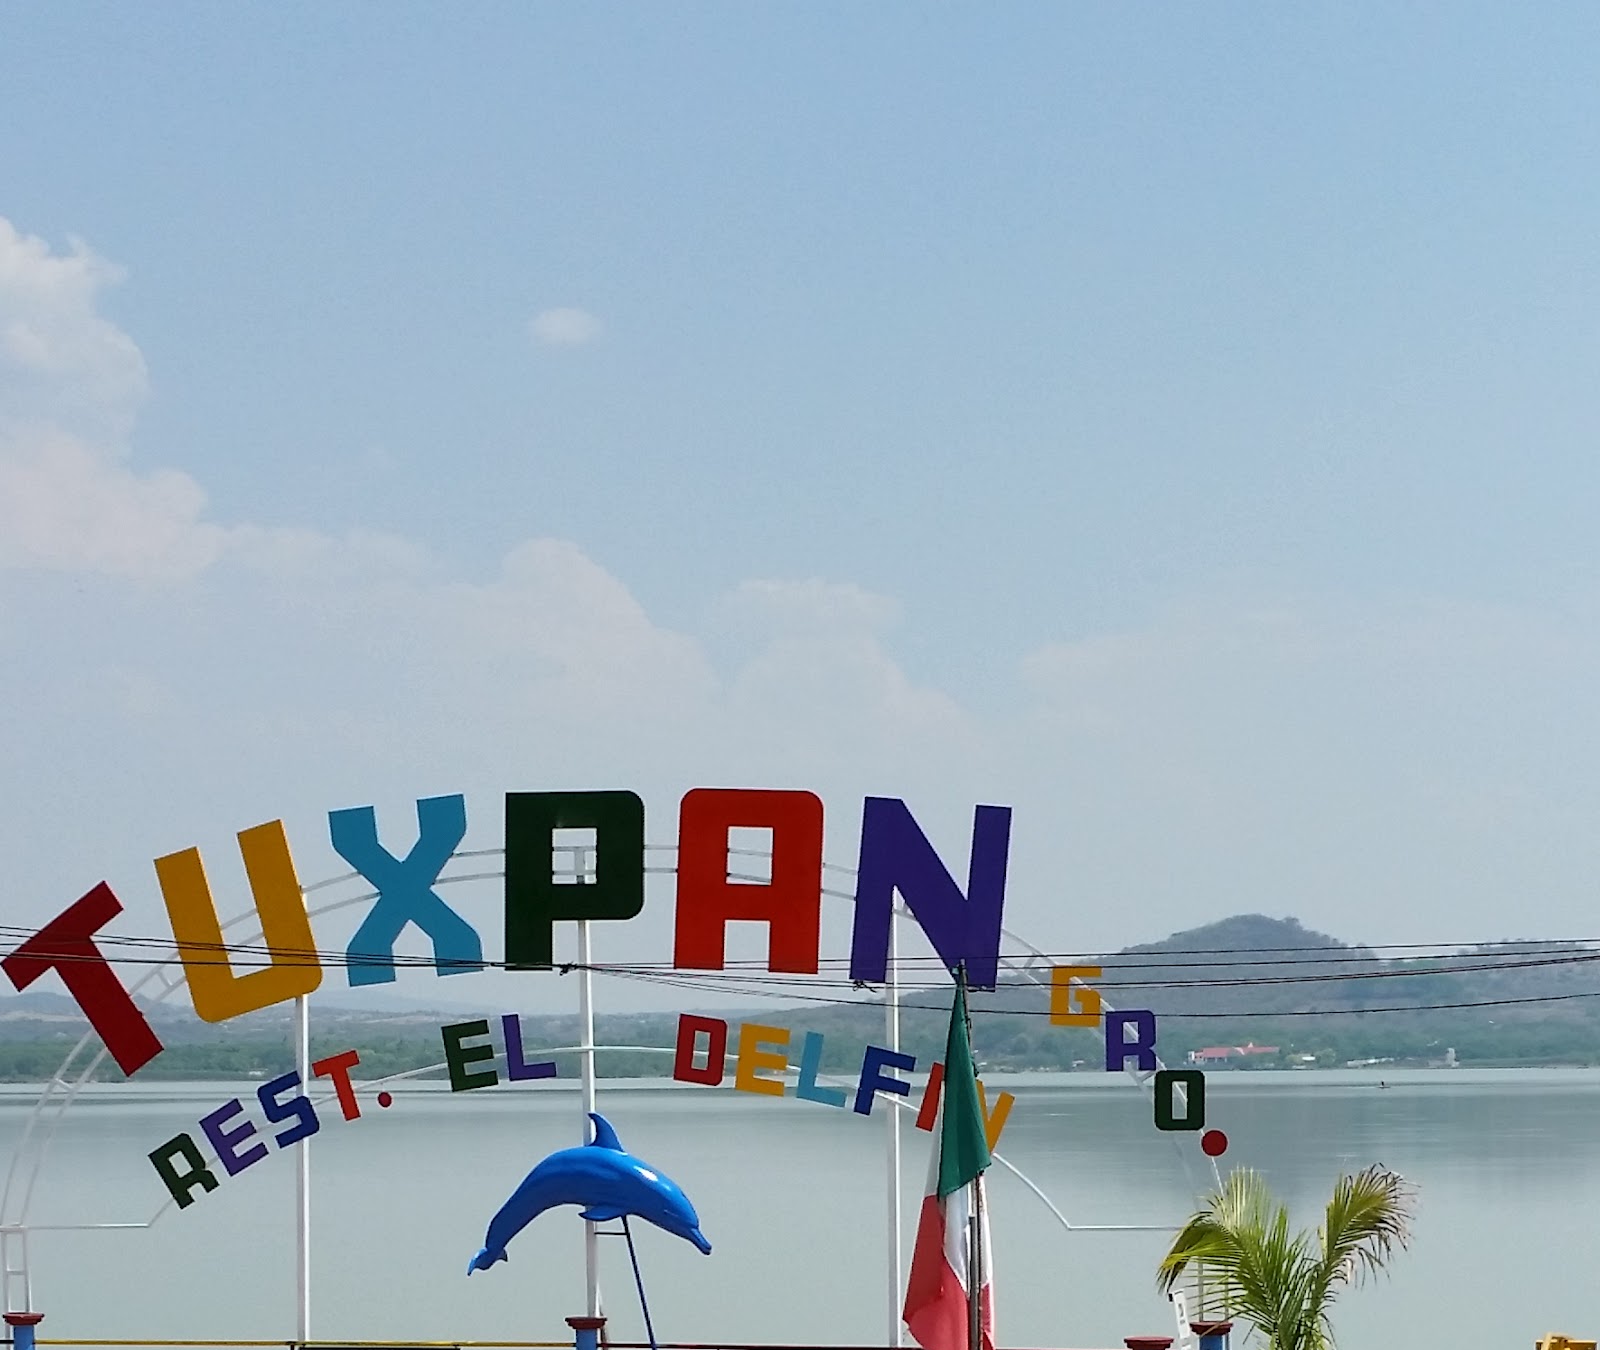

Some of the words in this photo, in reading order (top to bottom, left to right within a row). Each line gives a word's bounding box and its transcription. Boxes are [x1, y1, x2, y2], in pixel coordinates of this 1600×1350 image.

[0, 788, 1012, 1078] TUXPAN
[148, 1049, 394, 1211] REST.
[440, 1013, 557, 1093] EL
